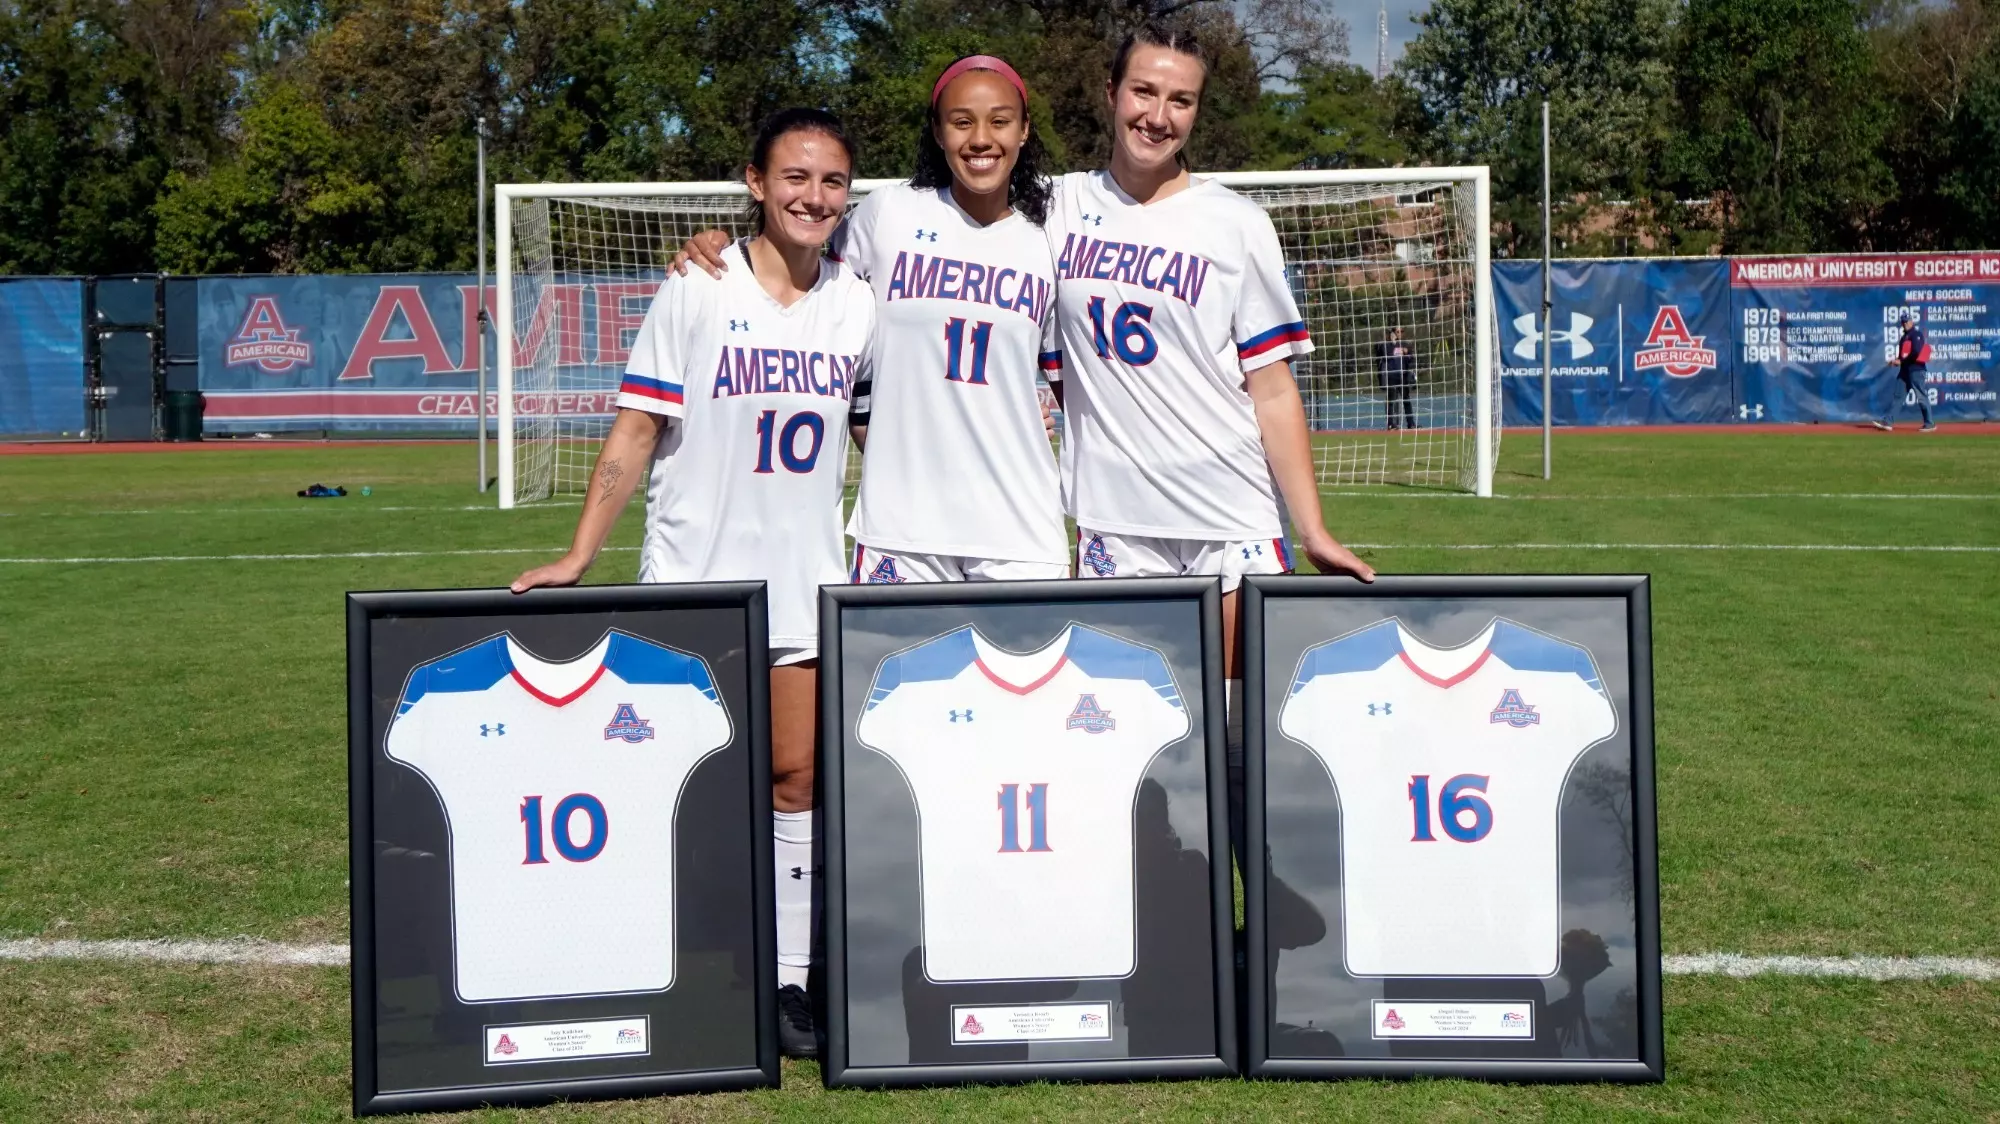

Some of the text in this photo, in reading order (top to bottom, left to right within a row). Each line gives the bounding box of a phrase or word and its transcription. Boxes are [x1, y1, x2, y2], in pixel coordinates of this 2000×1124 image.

[1058, 232, 1210, 309] AMERICAN
[1737, 262, 1814, 279] AMERICAN
[1819, 260, 1908, 278] UNIVERSITY
[1914, 259, 1974, 277] SOCCER
[886, 250, 1051, 328] AMERICAN
[1905, 289, 1972, 300] MEN'S SOCCER
[1943, 305, 1987, 313] CHAMPIONS
[1744, 308, 1780, 325] 1978
[1786, 311, 1847, 320] NCAA FIRST ROUND
[1928, 313, 1974, 322] NCAA FINALS
[1087, 295, 1159, 367] 16
[1744, 327, 1780, 344] 1979
[1802, 326, 1843, 334] CHAMPIONS
[1928, 329, 1947, 338] NCAA
[1787, 334, 1866, 343] NCAA QUARTERFINALS
[233, 344, 306, 359] AMERICAN
[944, 316, 994, 386] 11
[1803, 346, 1844, 354] CHAMPIONS
[1937, 344, 1981, 352] CHAMPIONS
[1639, 351, 1712, 365] AMERICAN
[1743, 345, 1780, 363] 1984
[1809, 353, 1838, 361] SECOND
[1838, 353, 1862, 361] ROUND
[712, 345, 859, 402] AMERICAN
[1550, 366, 1609, 376] ARMOUR
[1945, 371, 1981, 382] SOCCER
[1954, 392, 1997, 401] CHAMPIONS
[753, 409, 825, 474] 10
[1493, 711, 1537, 722] AMERICAN
[1069, 718, 1113, 728] AMERICAN
[608, 727, 651, 737] AMERICAN
[1408, 773, 1494, 844] 16
[997, 783, 1054, 853] 11
[520, 792, 609, 865] 10
